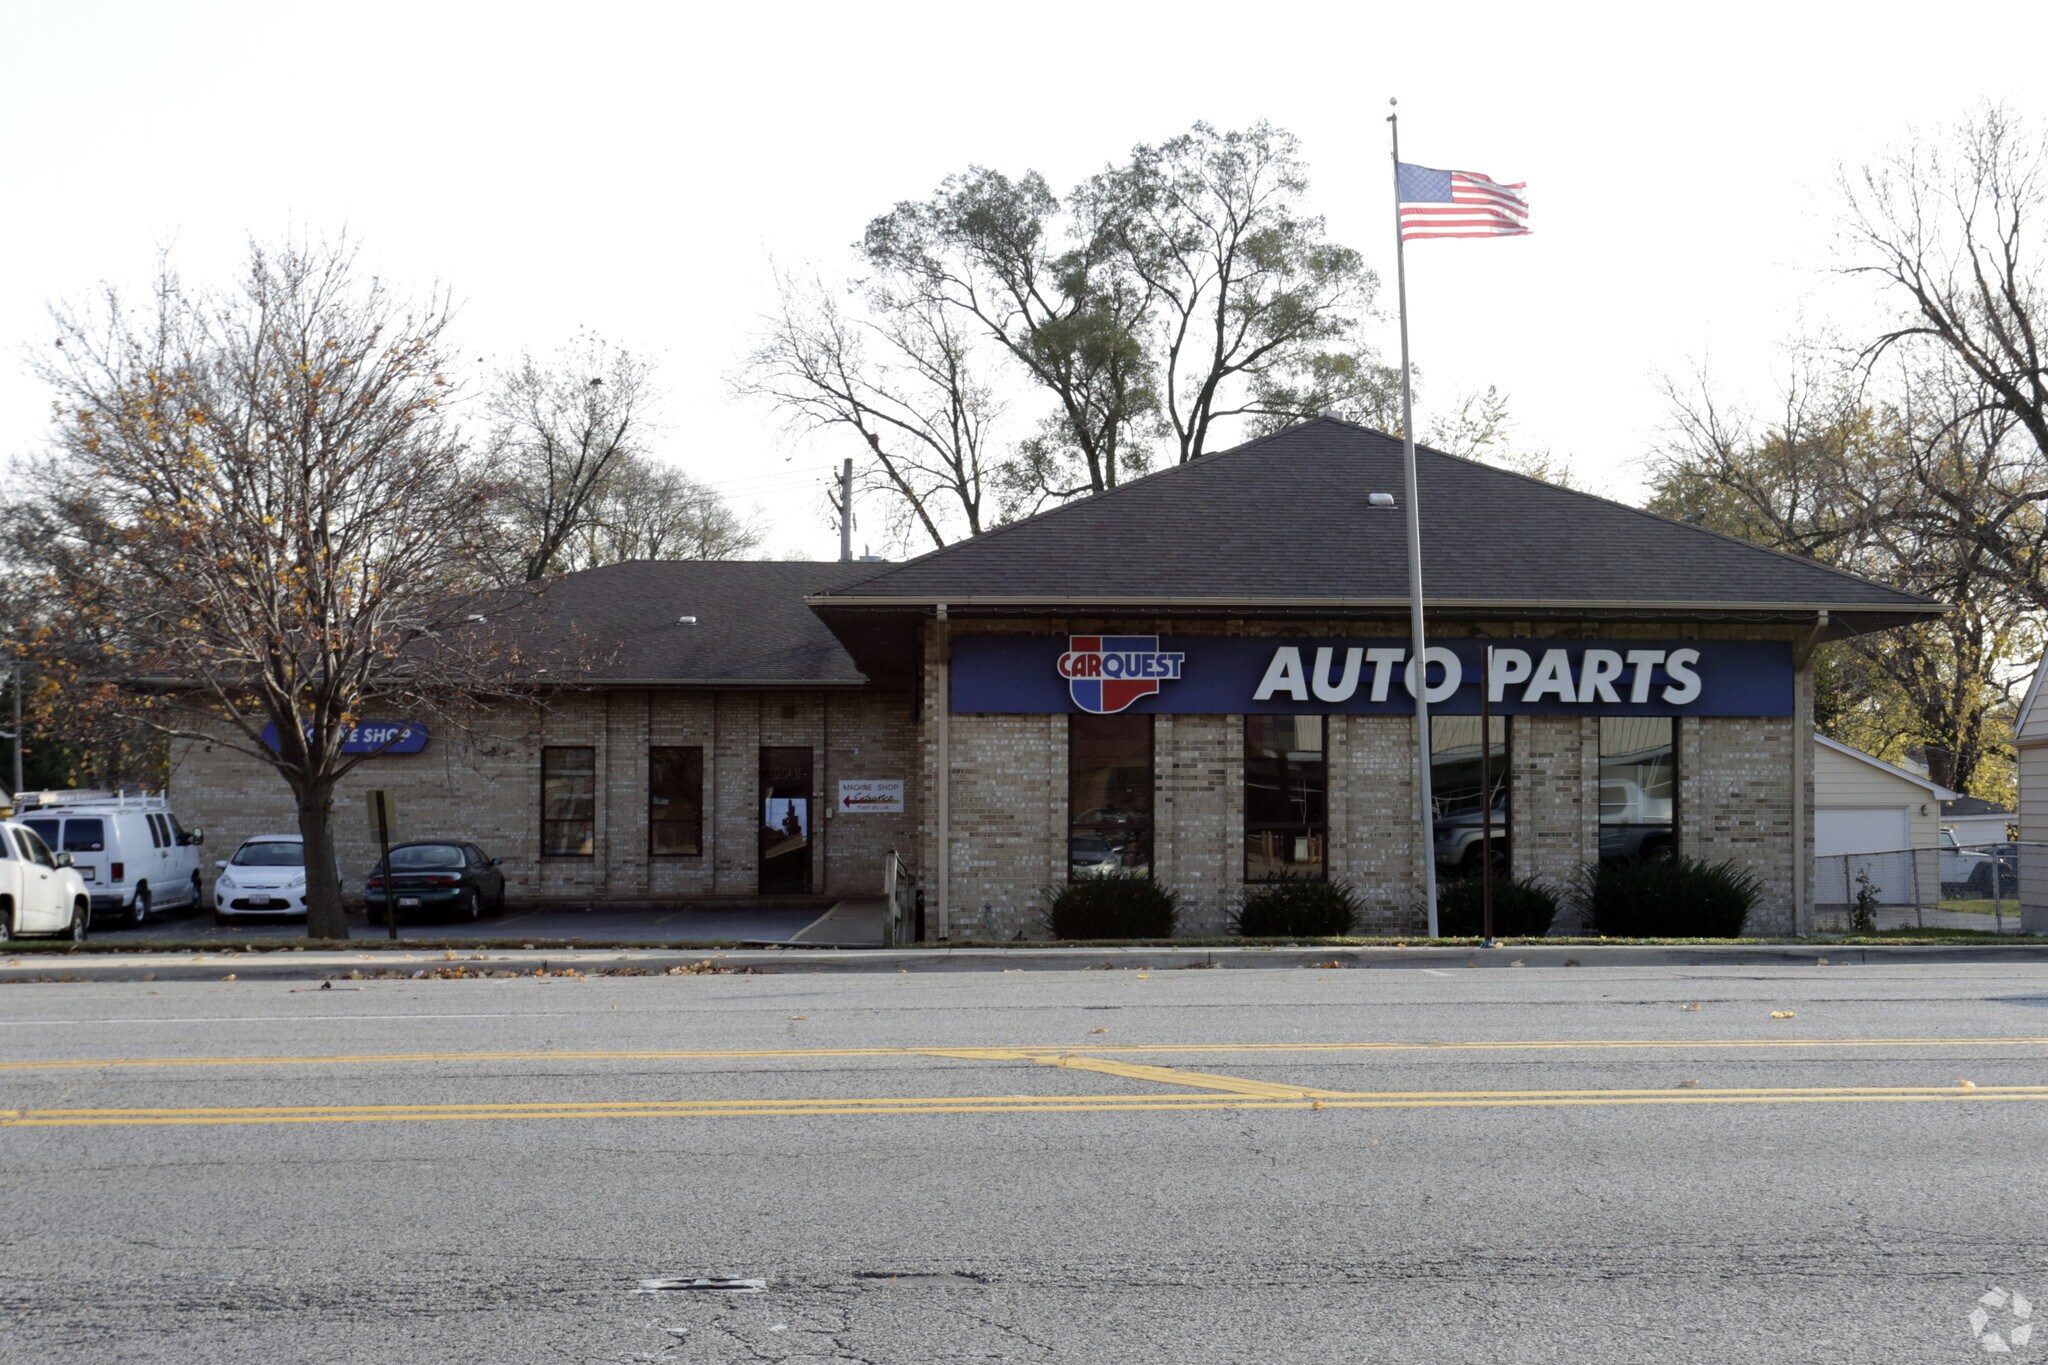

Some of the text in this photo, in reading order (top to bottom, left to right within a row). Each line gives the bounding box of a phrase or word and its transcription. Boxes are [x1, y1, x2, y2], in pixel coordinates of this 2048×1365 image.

[1059, 653, 1184, 679] CARQUEST
[1252, 645, 1702, 705] AUTO PARTS
